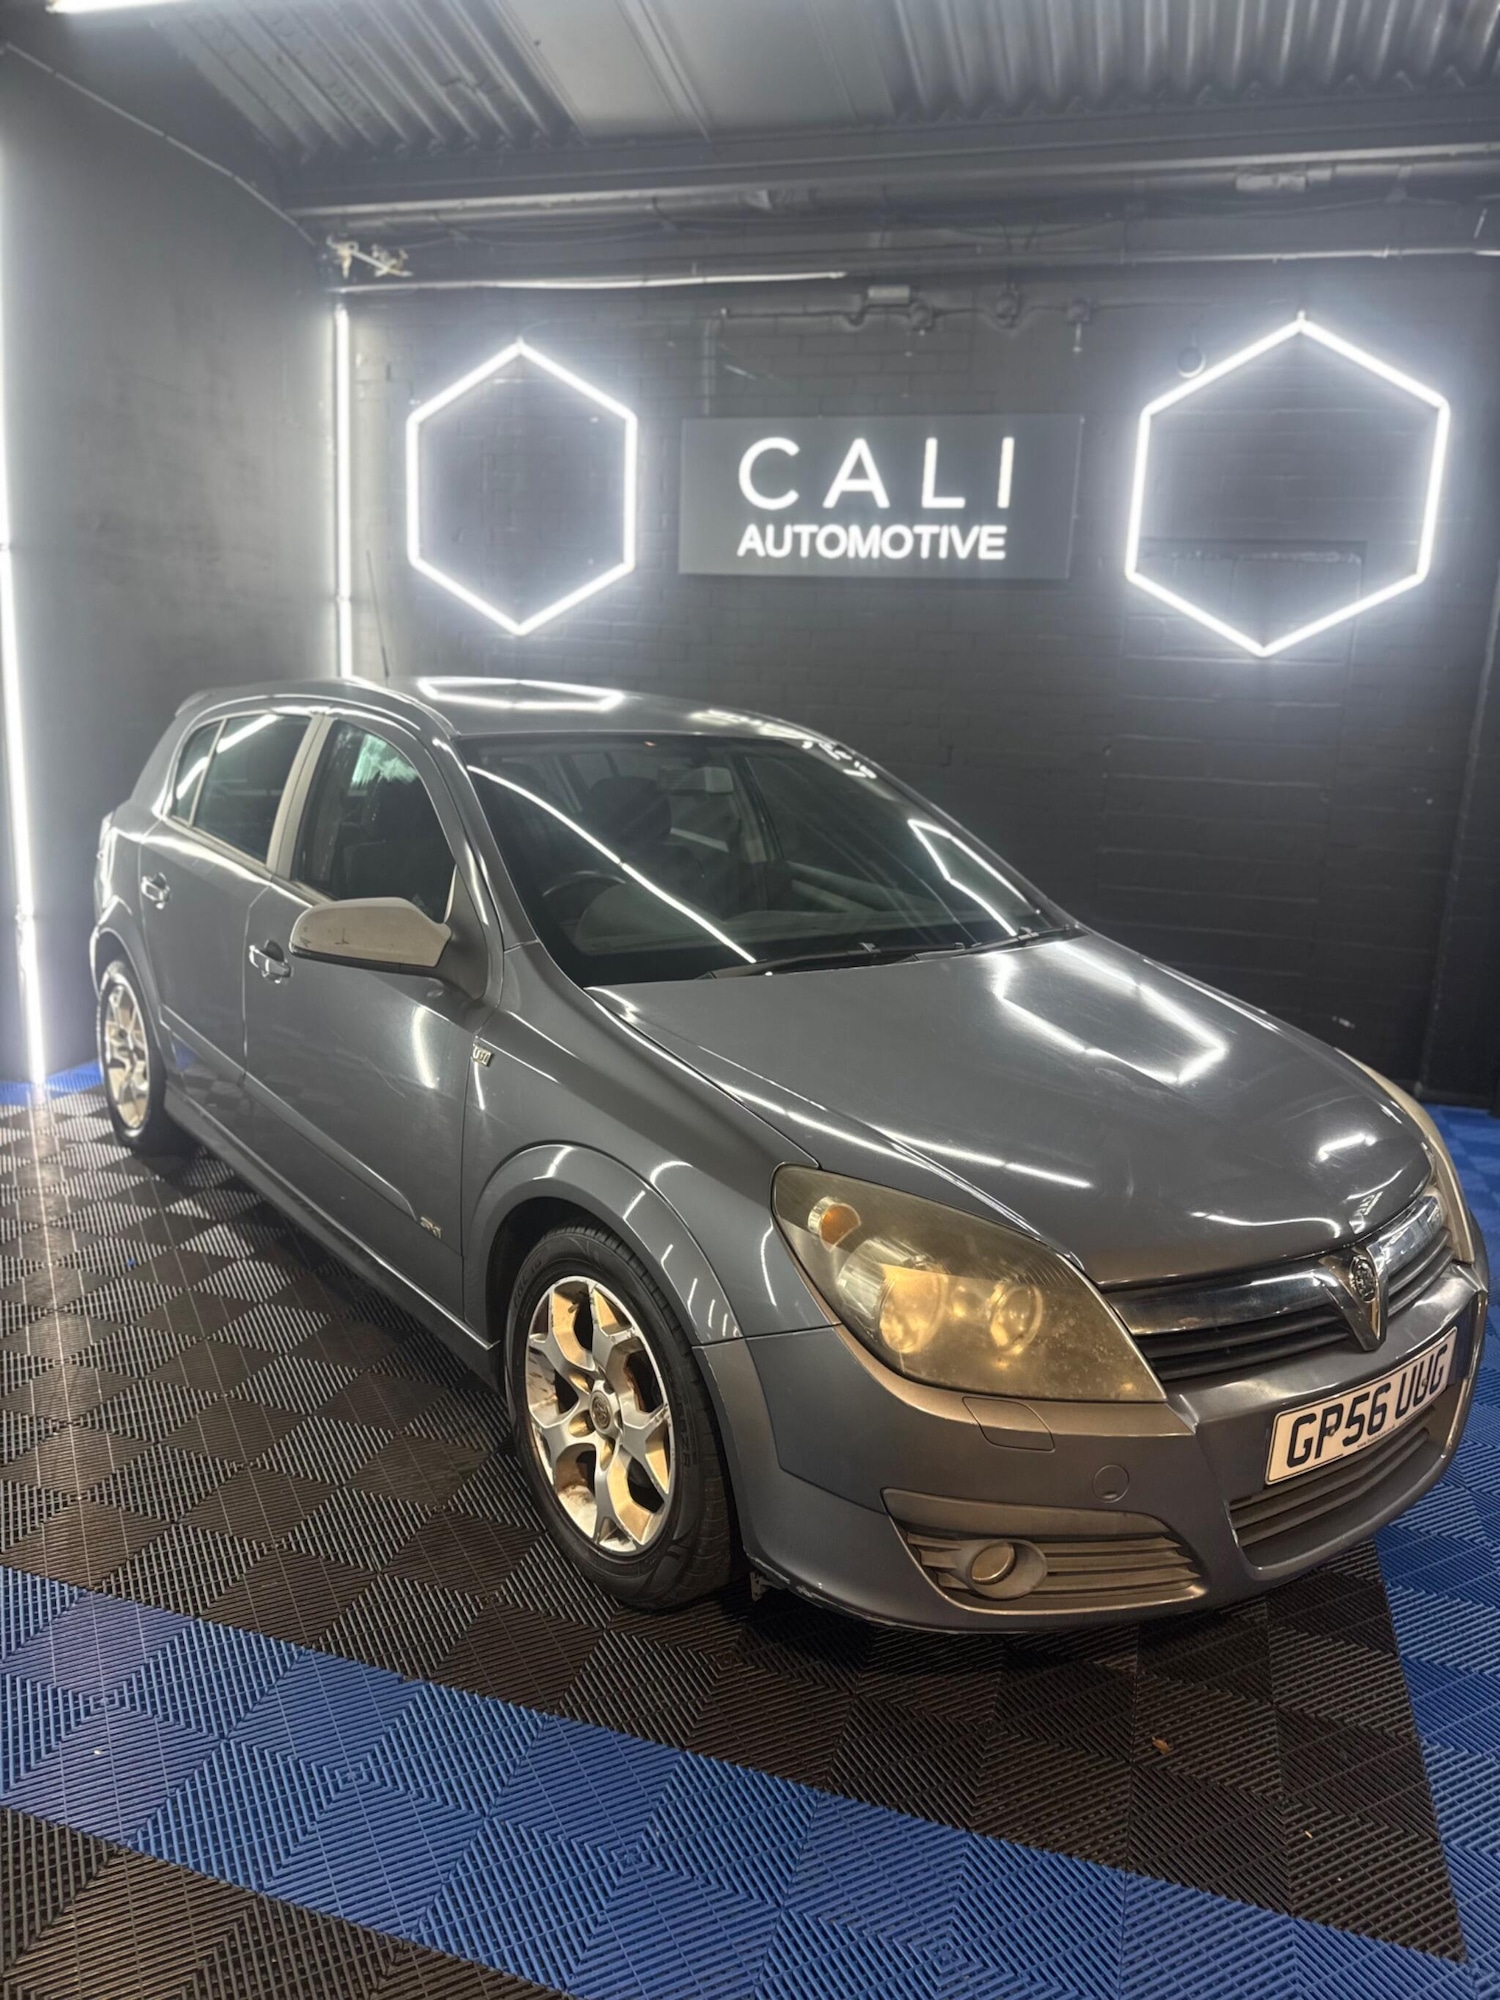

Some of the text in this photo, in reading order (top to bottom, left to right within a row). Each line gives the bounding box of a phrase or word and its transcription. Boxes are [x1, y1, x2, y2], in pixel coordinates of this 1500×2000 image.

[738, 436, 1015, 510] CALI
[737, 523, 1007, 560] AUTOMOTIVE
[1286, 1343, 1448, 1467] GP56 UUG
